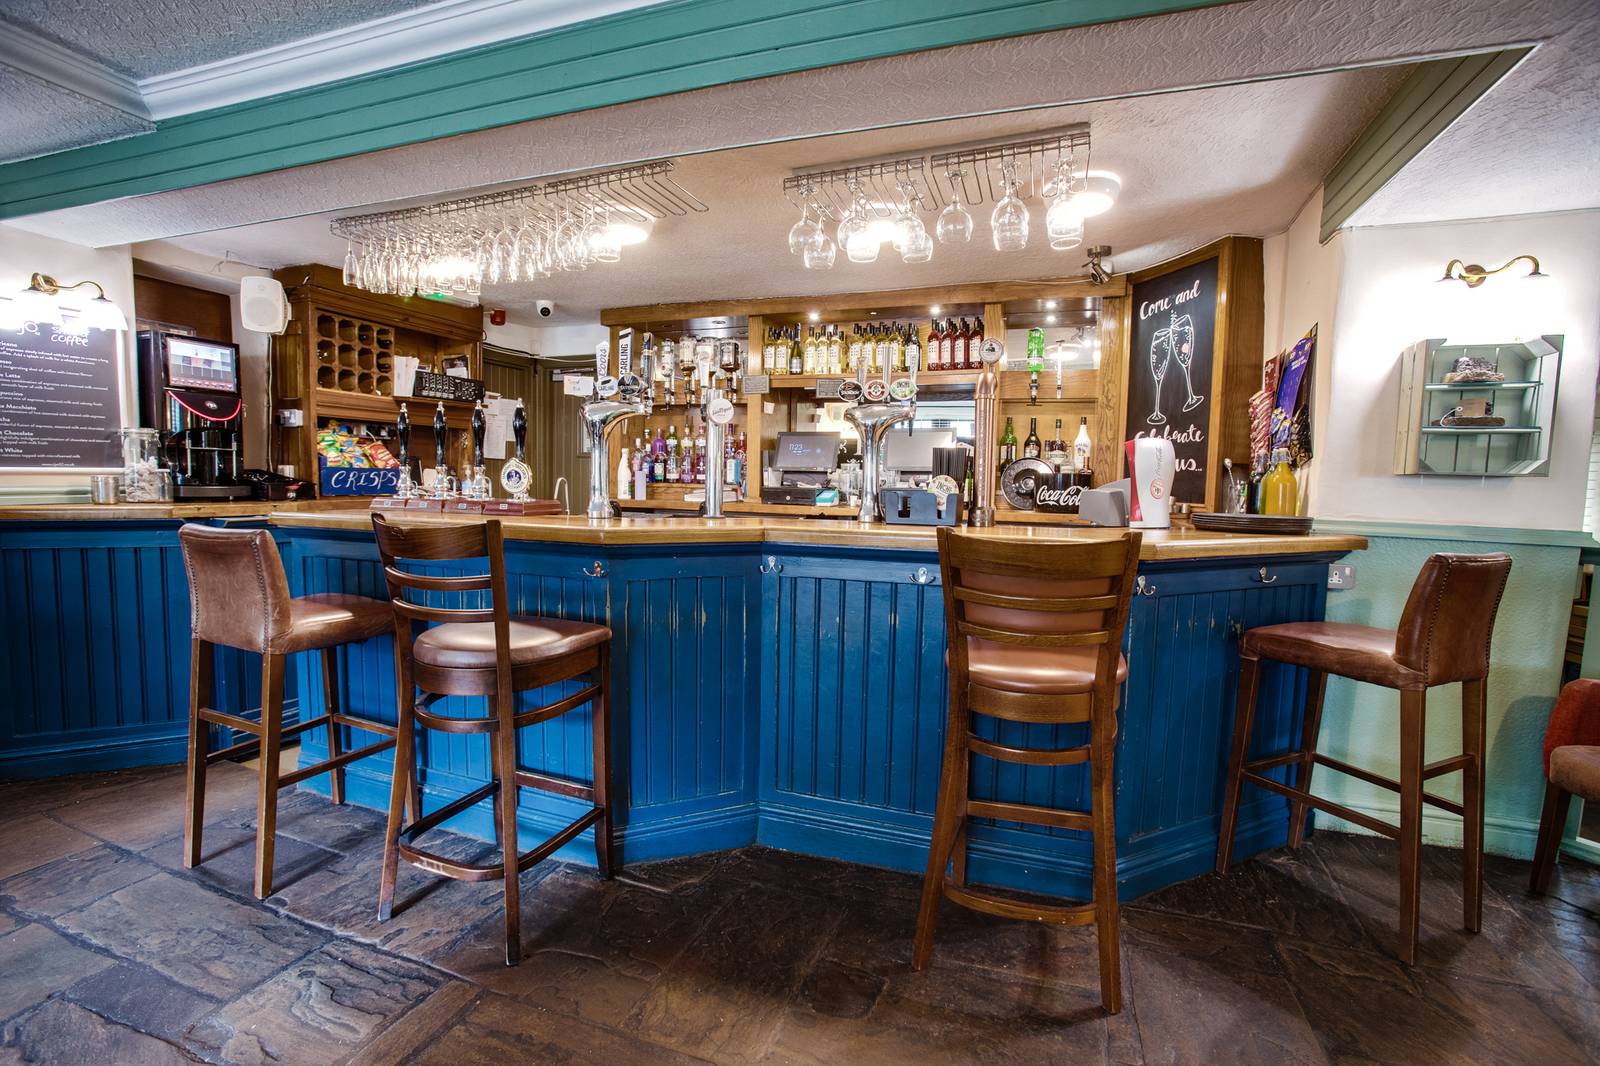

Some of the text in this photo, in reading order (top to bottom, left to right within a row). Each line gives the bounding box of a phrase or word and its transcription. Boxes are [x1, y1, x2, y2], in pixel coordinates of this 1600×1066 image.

[1176, 280, 1200, 304] and
[599, 348, 608, 376] Coors
[620, 344, 628, 375] CARLING
[331, 470, 397, 490] CRISPS
[1036, 485, 1086, 506] Coca-Col
